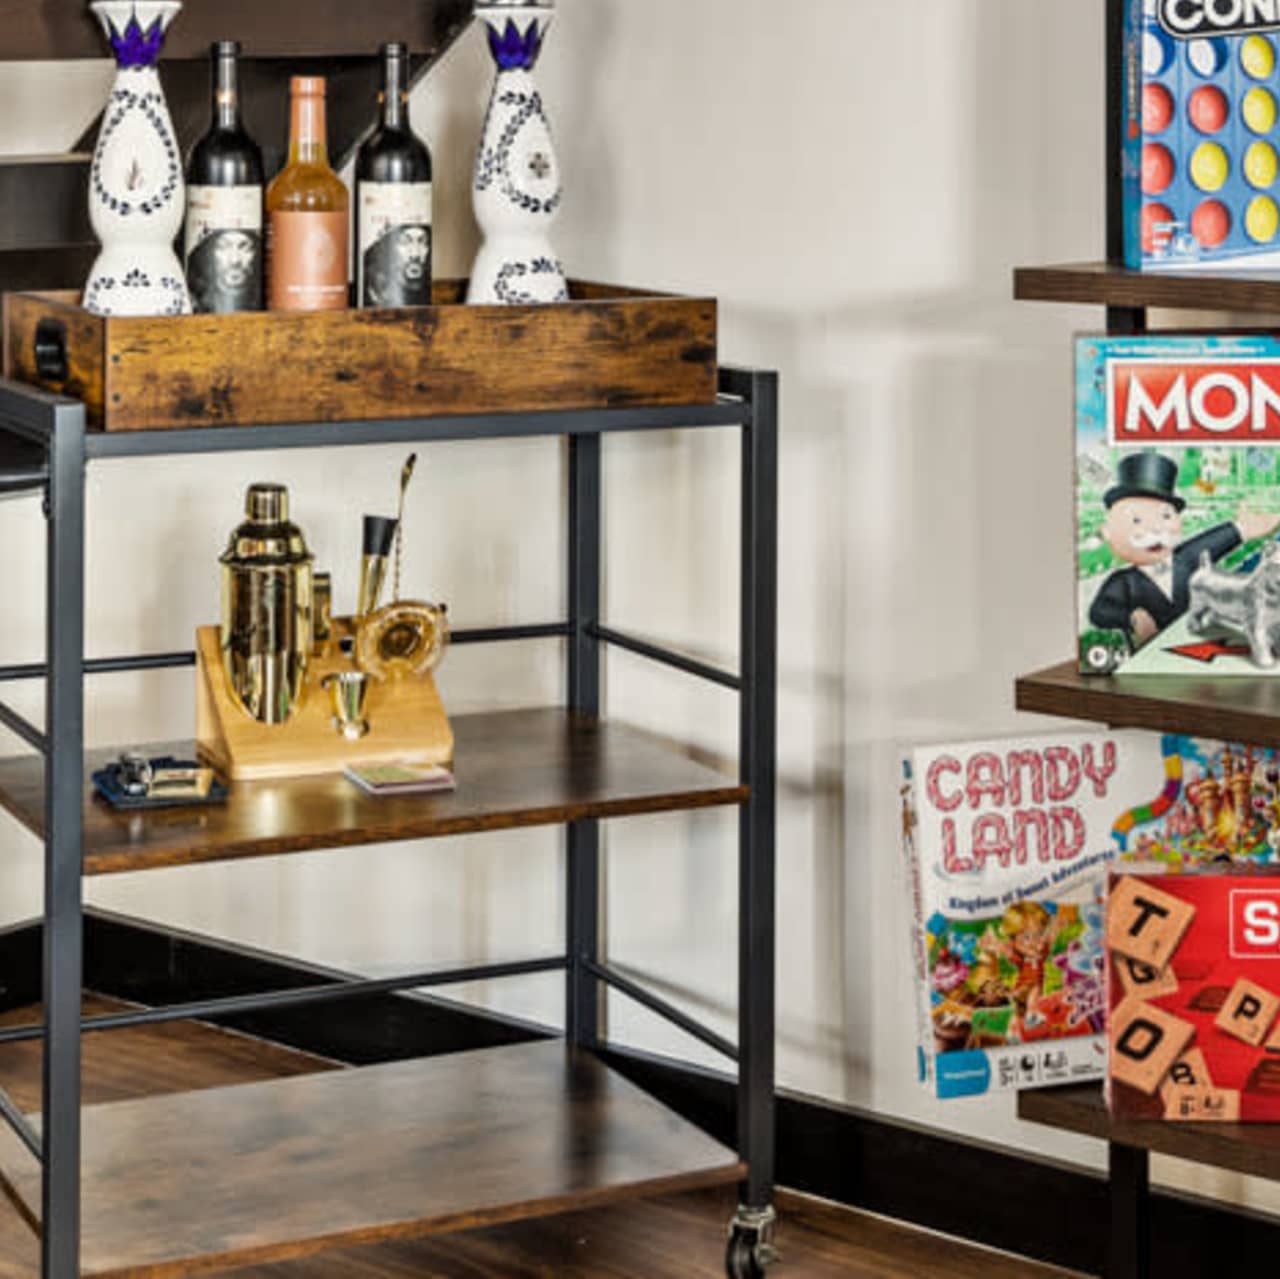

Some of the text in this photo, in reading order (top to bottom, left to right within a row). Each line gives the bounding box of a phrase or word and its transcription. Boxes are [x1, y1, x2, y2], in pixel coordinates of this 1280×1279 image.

[926, 740, 1118, 812] CANDY
[941, 806, 1086, 874] LAND
[949, 896, 999, 912] Kingdom
[1051, 850, 1116, 882] Adventures
[1128, 895, 1170, 937] T
